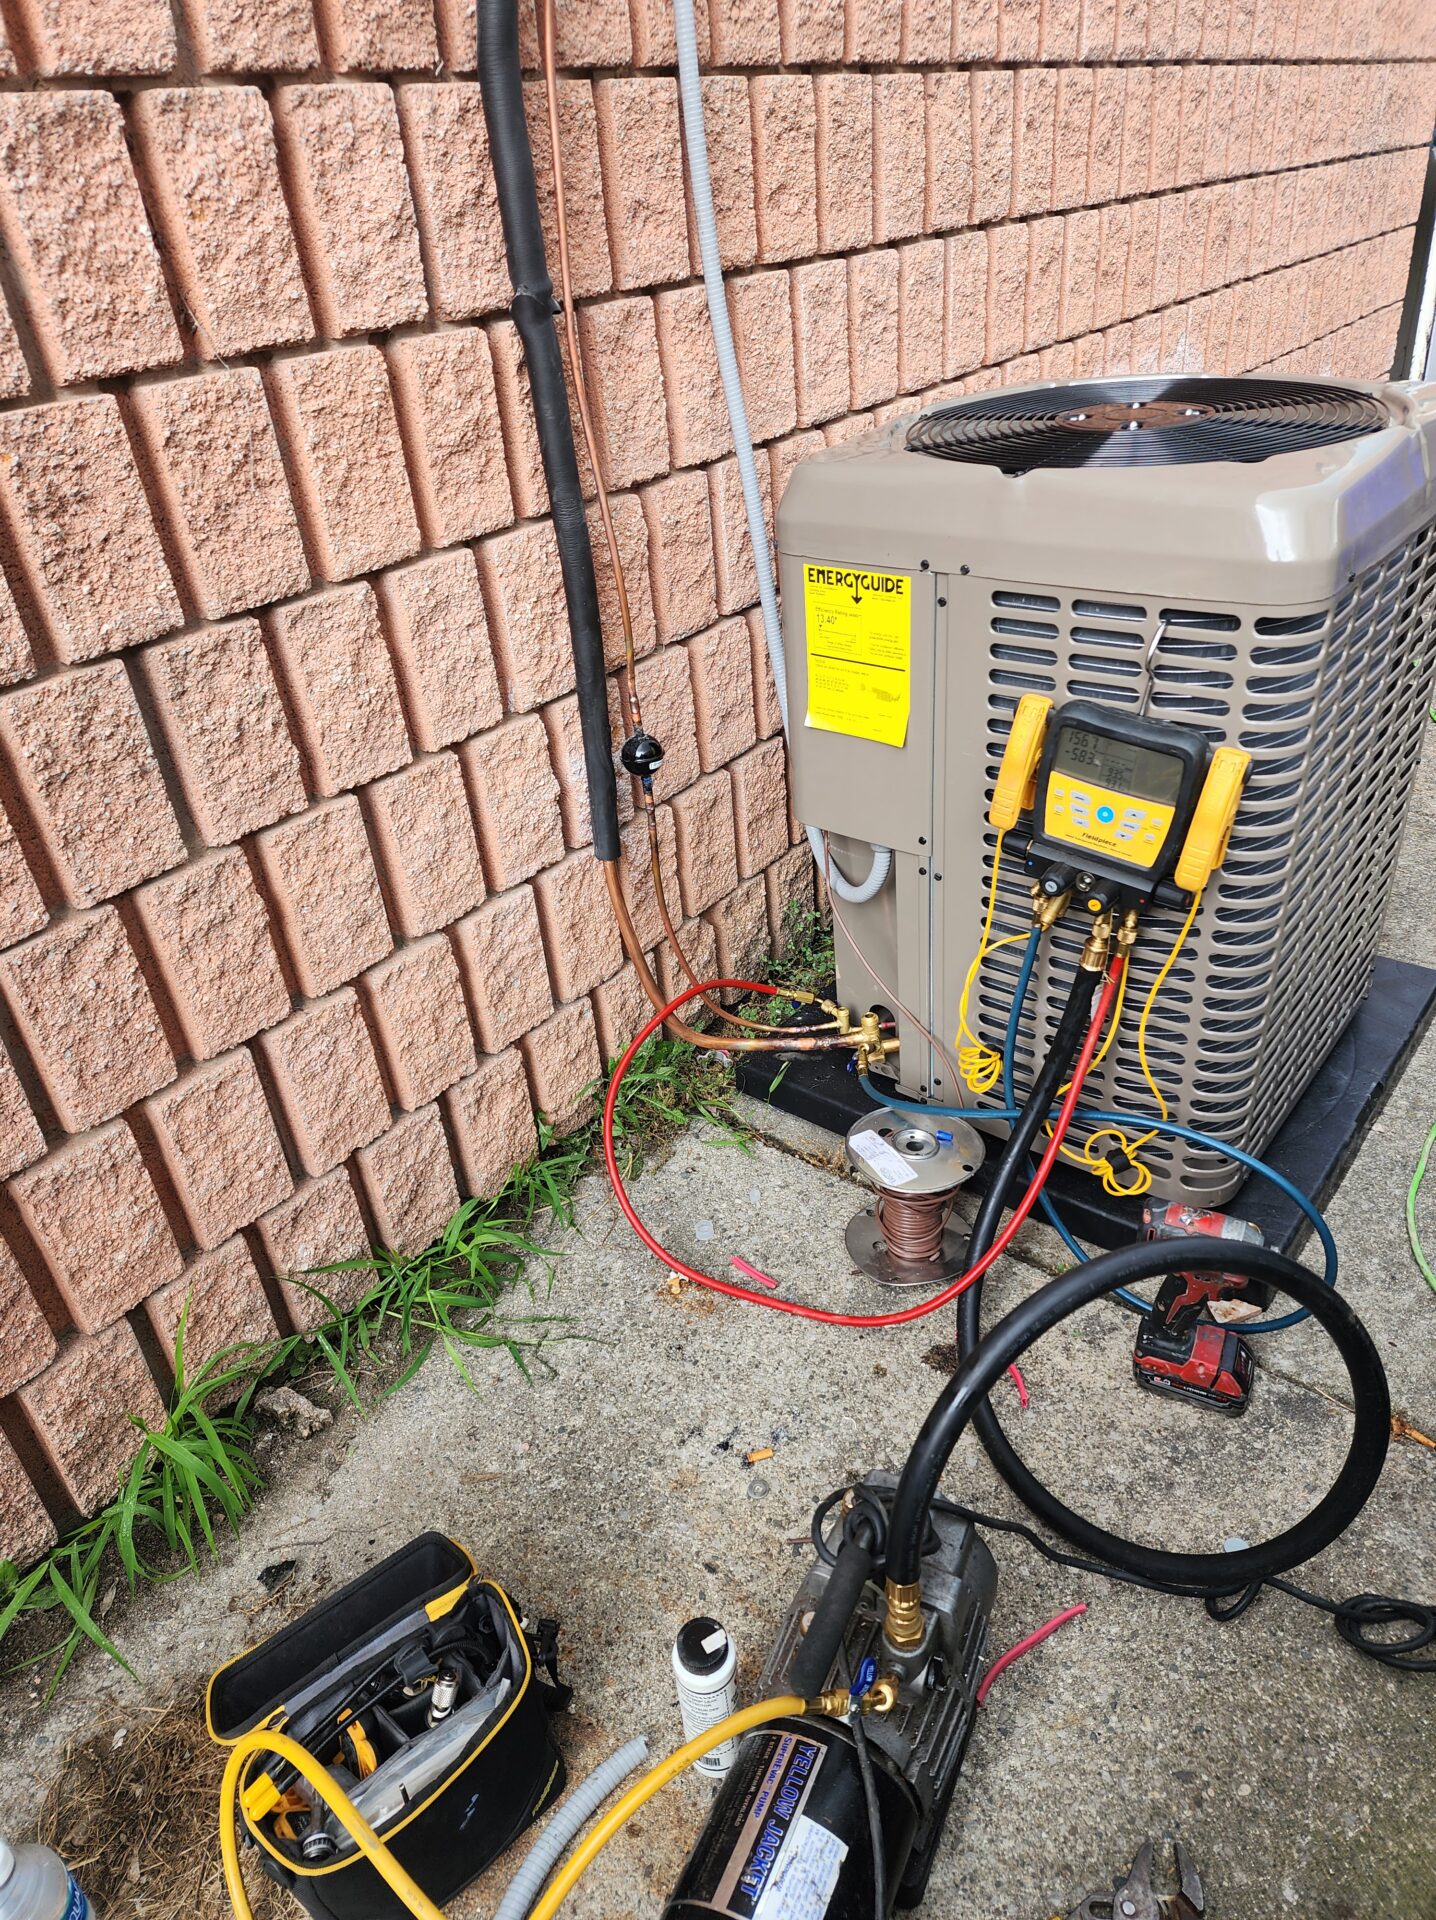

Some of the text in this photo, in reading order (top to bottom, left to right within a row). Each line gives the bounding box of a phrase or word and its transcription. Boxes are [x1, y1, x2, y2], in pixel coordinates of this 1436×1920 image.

[808, 567, 904, 595] ENERGYGUIDE
[1082, 832, 1118, 847] Fieldpiece
[773, 1744, 817, 1820] YELLOW
[752, 1790, 769, 1818] PUMP
[739, 1818, 784, 1899] JACKET
